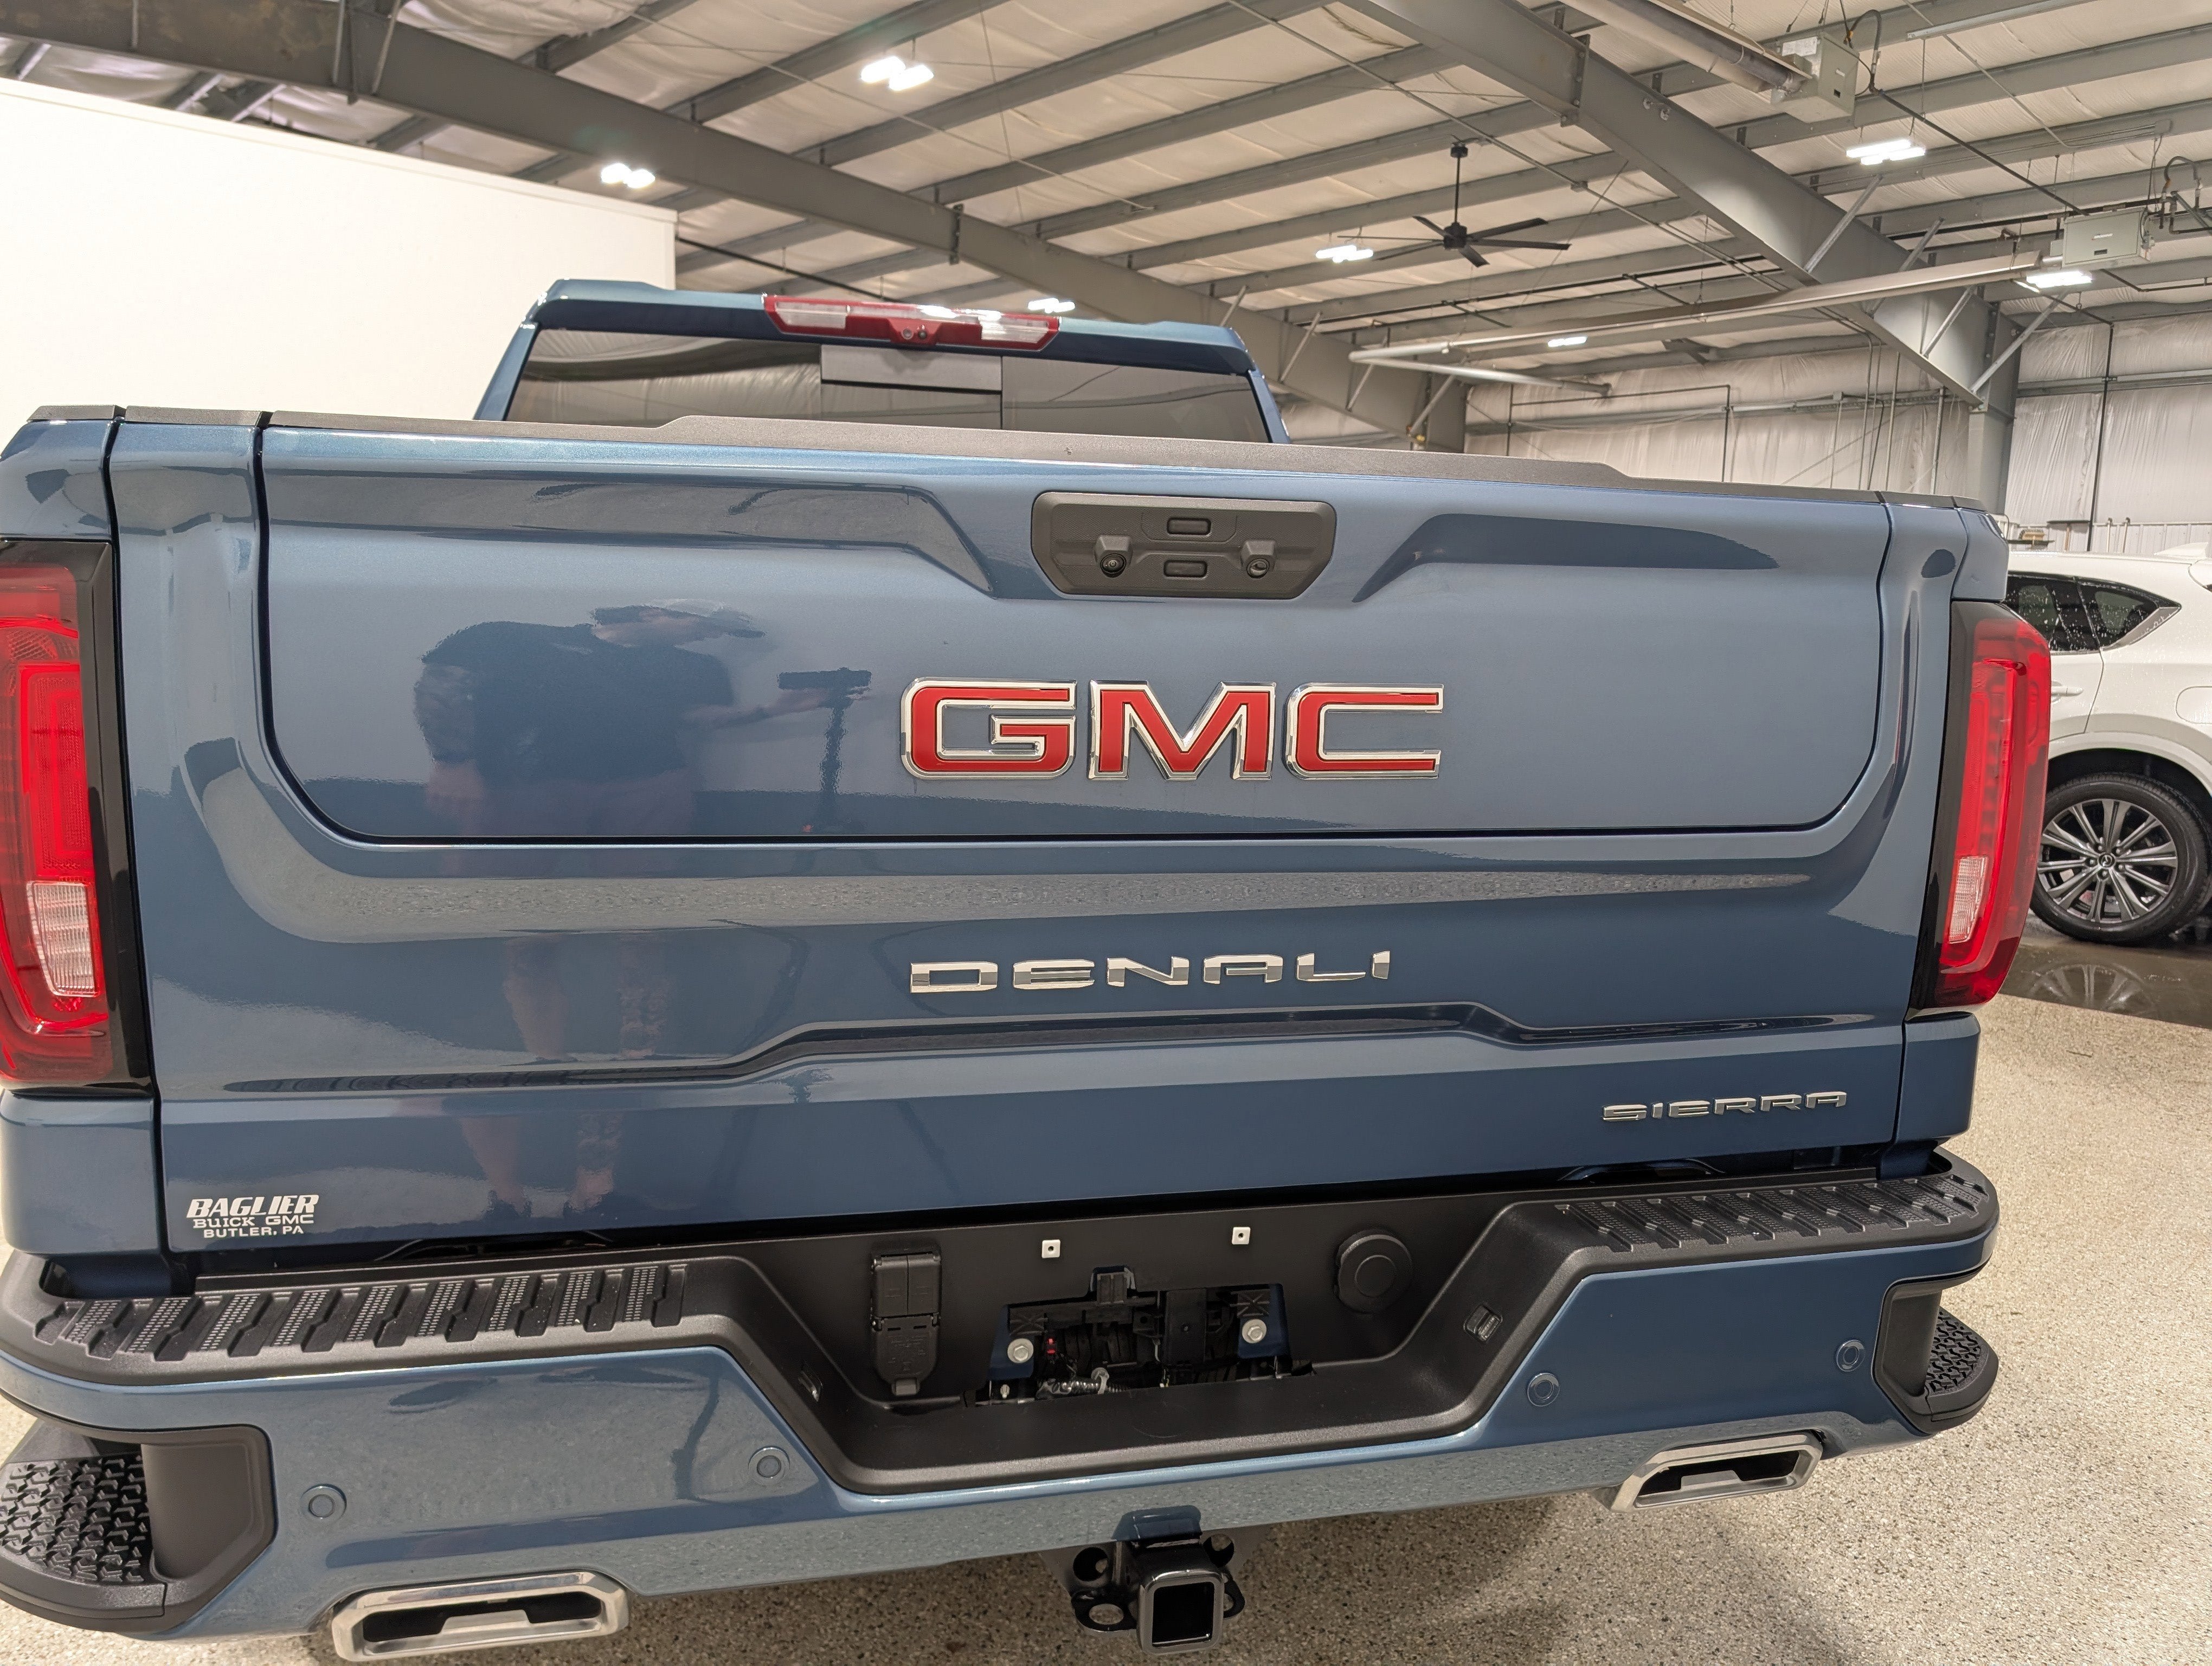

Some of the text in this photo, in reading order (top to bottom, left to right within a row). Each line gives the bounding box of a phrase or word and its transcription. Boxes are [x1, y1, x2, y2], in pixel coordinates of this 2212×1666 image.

[901, 677, 1445, 781] GMC
[910, 950, 1391, 994] DENALI
[1602, 1091, 1847, 1122] SIERRA
[186, 1195, 319, 1218] BAGLIER
[193, 1214, 314, 1229] BUICK GMC
[203, 1225, 304, 1239] BUTLER, PA
